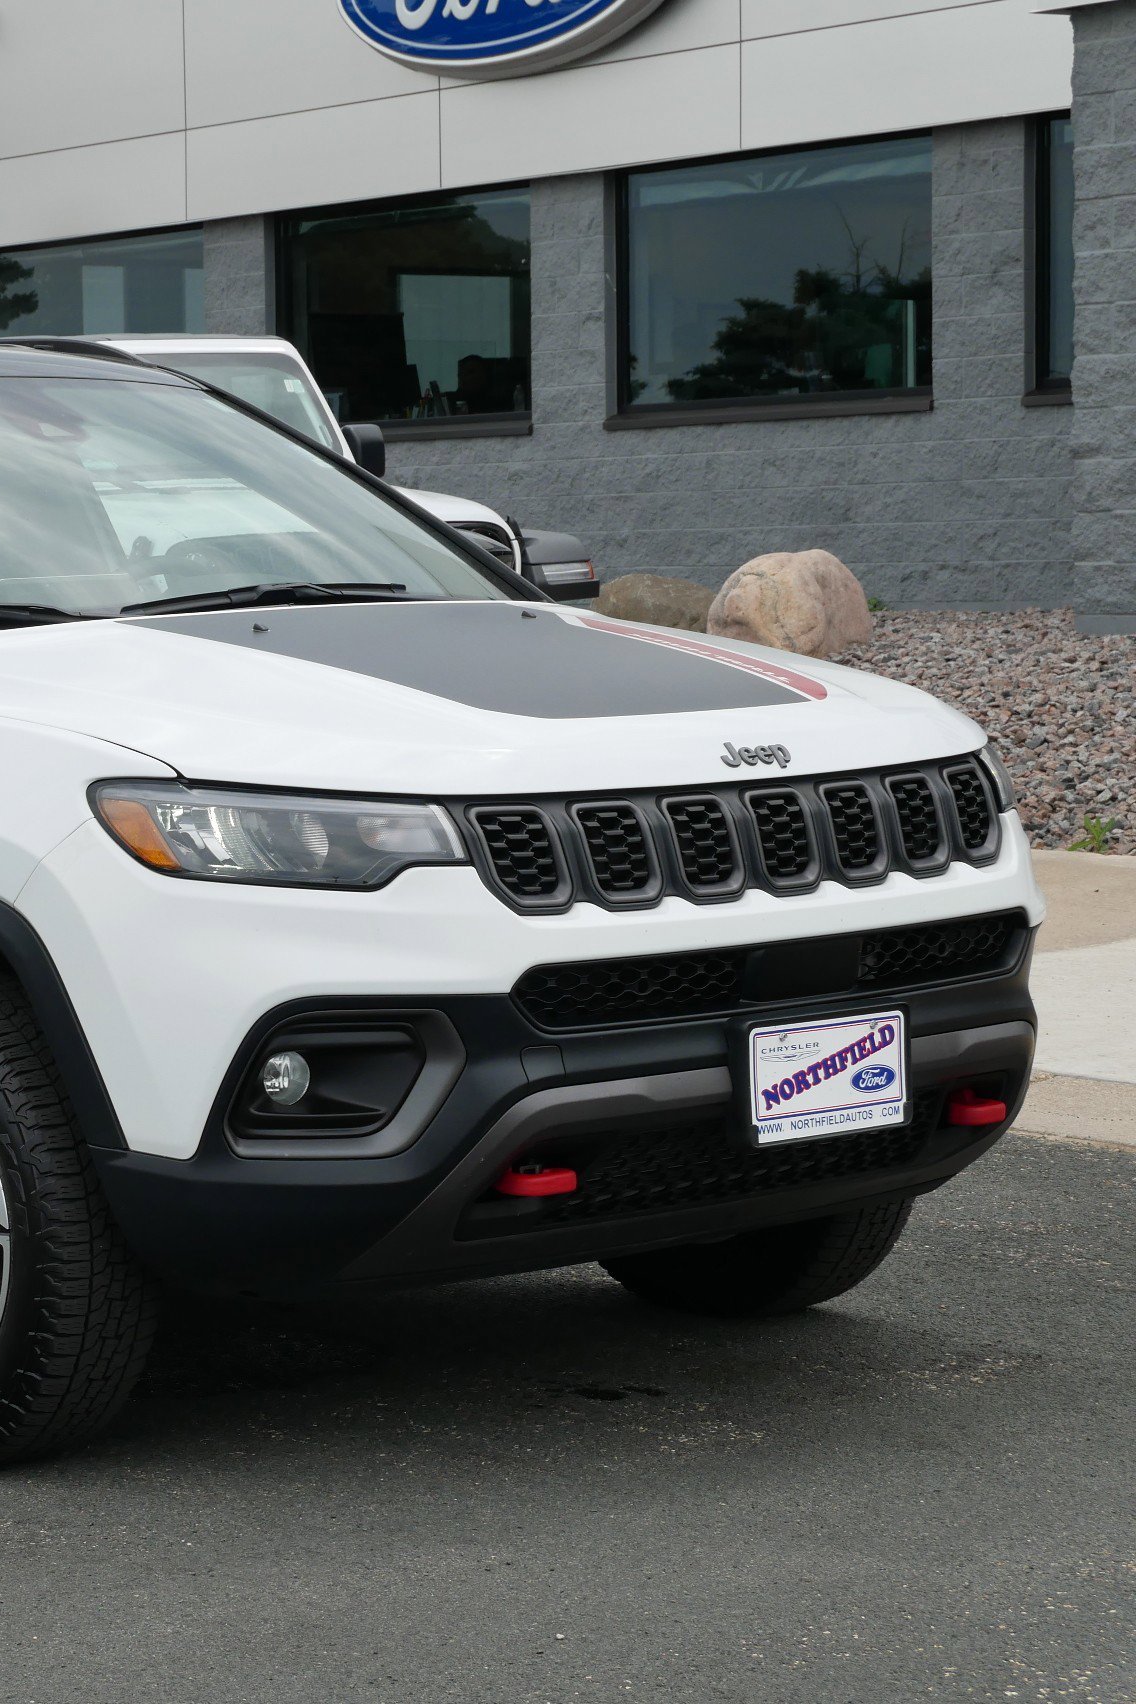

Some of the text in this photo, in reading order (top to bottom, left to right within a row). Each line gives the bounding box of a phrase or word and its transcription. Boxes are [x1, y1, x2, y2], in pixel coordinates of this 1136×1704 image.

[720, 741, 792, 769] Jeep
[761, 1041, 820, 1055] CHRYSLER
[761, 1023, 895, 1111] NORTHFIELD
[859, 1069, 887, 1087] Ford
